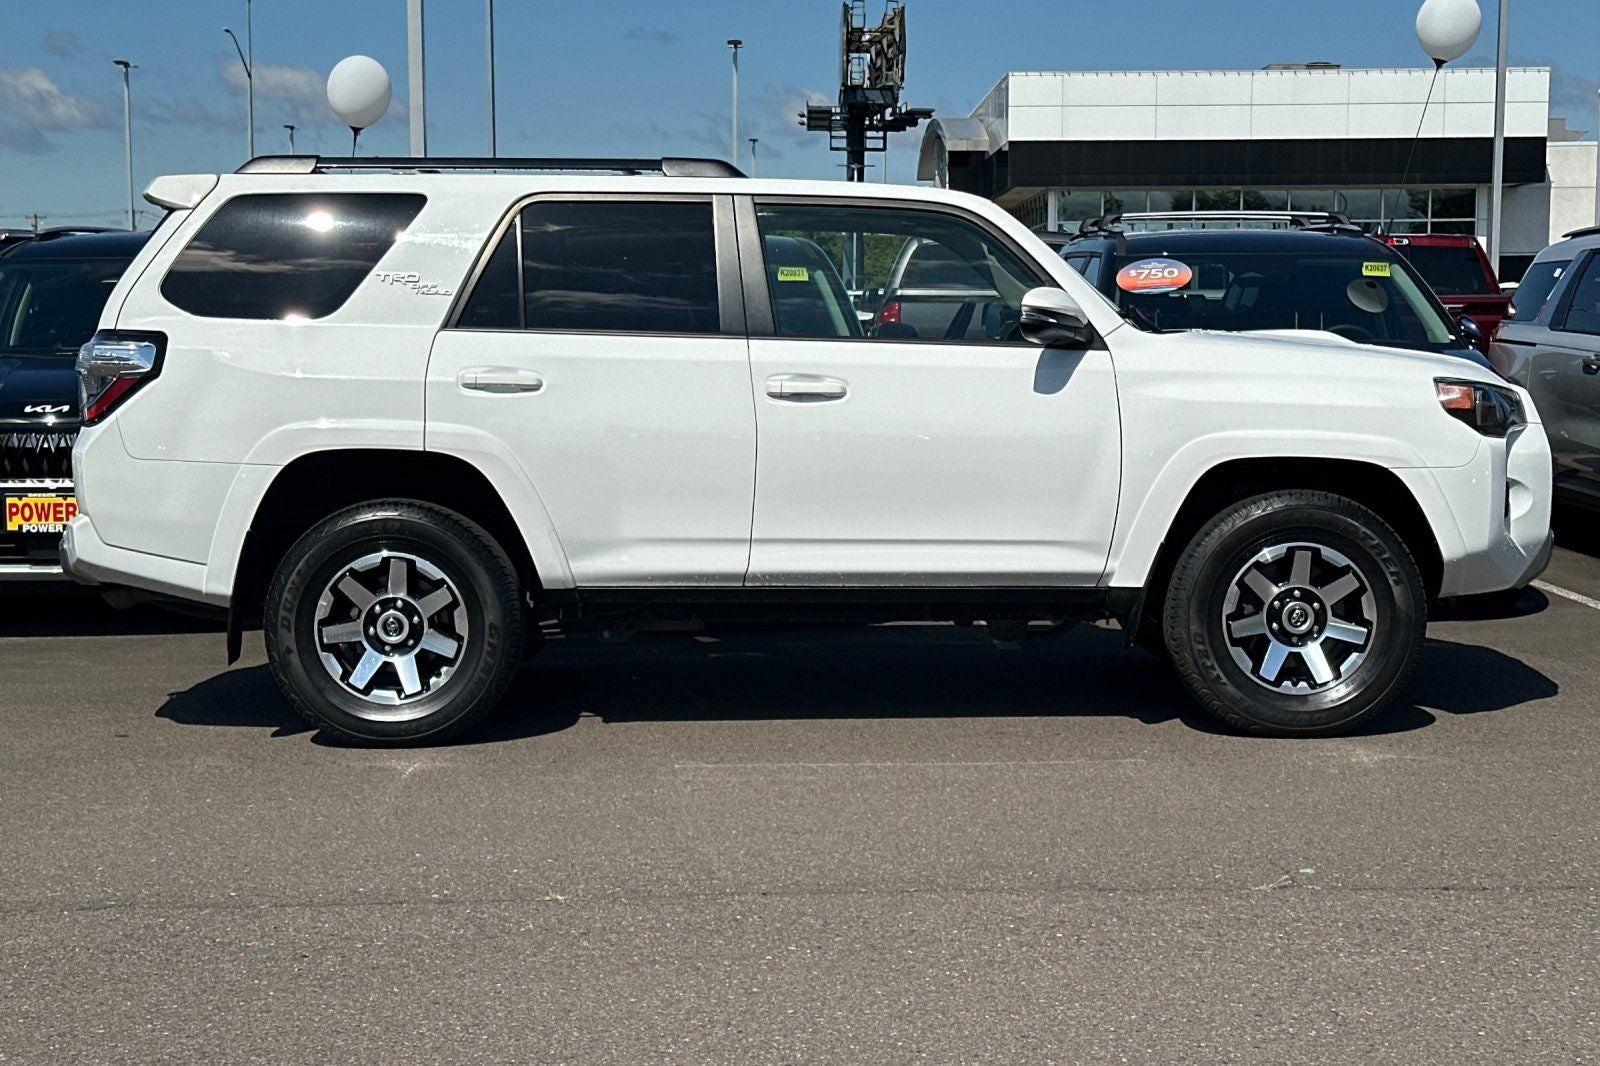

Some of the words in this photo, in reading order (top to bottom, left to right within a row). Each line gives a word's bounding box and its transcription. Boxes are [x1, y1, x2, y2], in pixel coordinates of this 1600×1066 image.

[1129, 267, 1179, 280] $750
[8, 502, 77, 522] POWER
[22, 524, 63, 533] POWER
